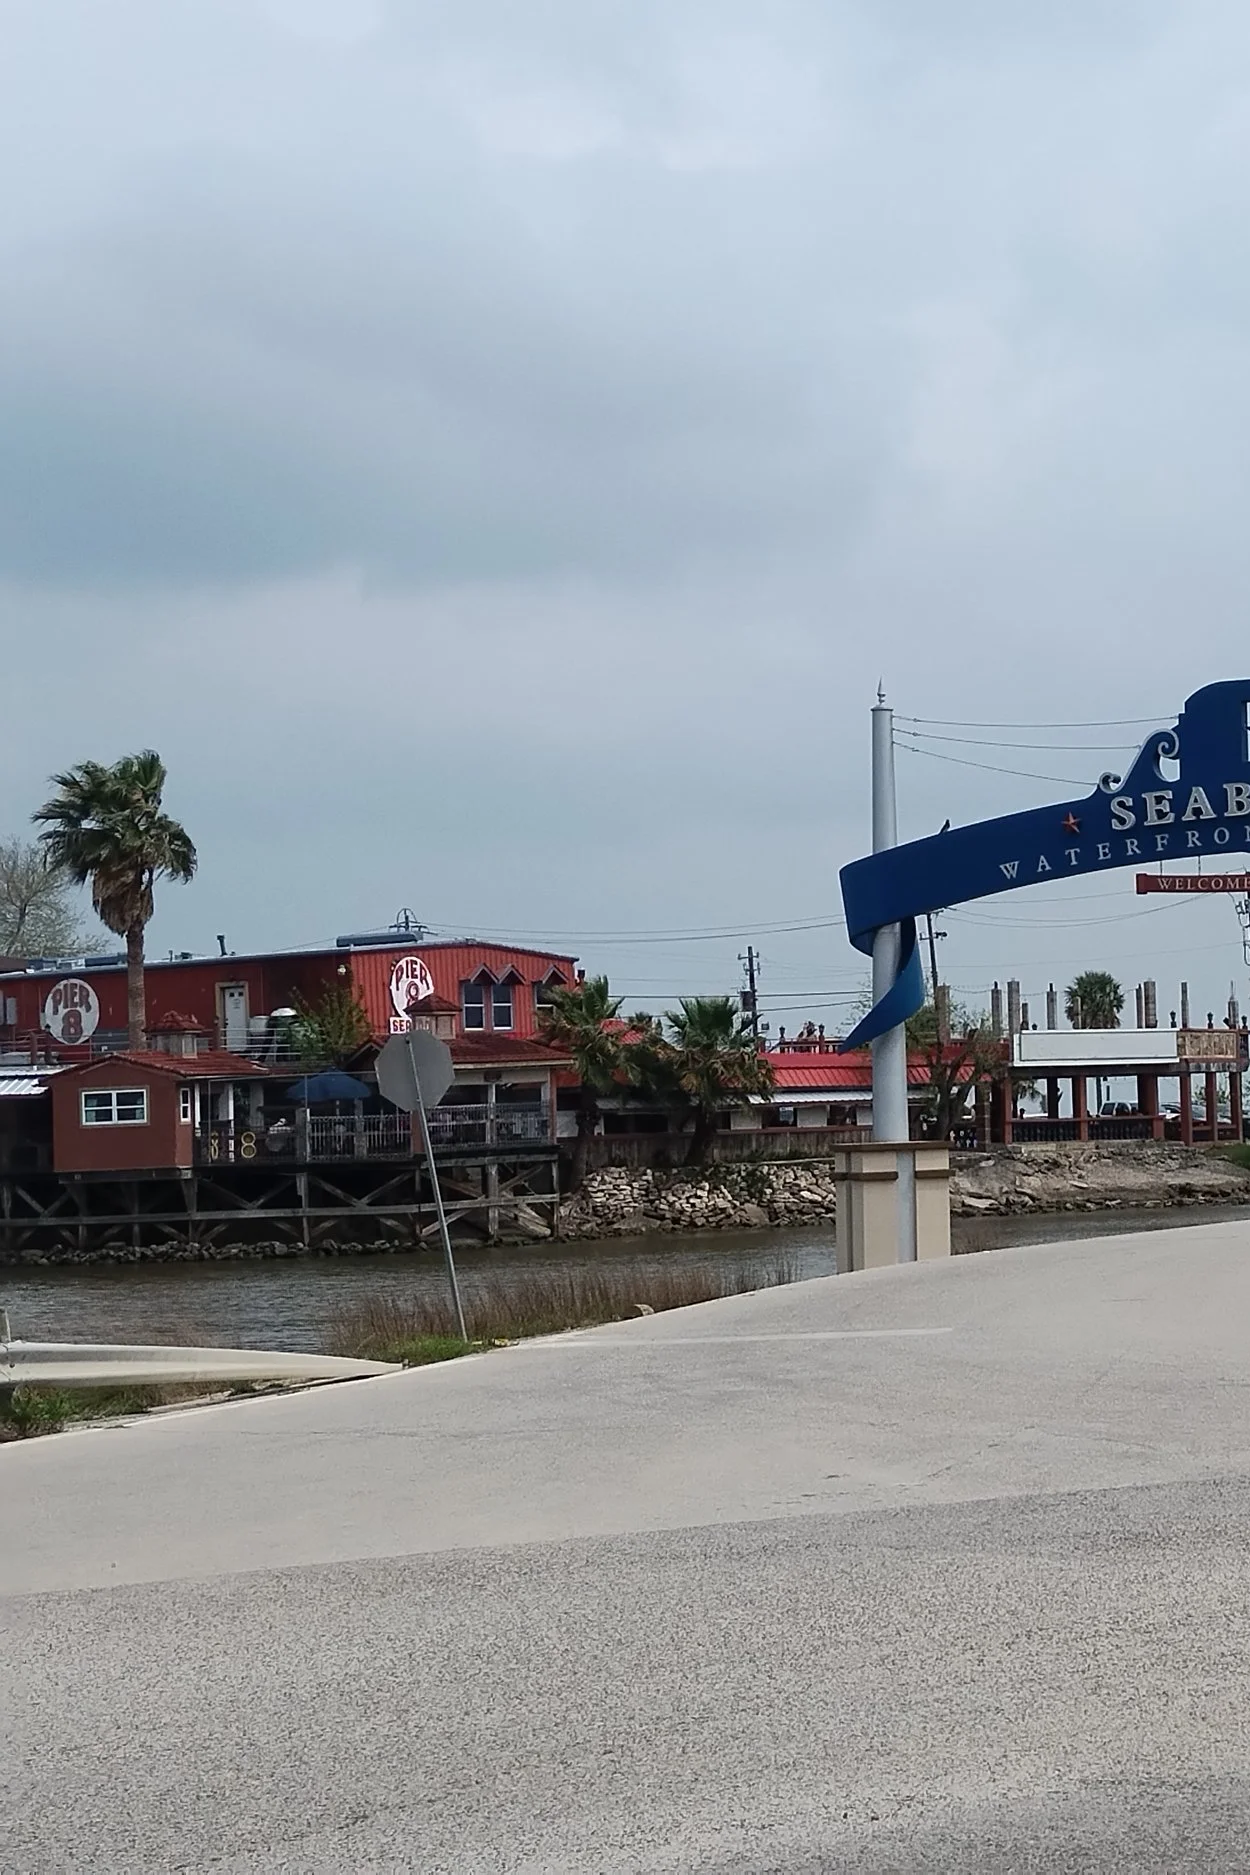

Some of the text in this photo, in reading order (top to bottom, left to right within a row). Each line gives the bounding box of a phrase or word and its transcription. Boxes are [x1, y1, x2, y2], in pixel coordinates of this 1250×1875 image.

[395, 959, 431, 992] PIER
[51, 982, 92, 1016] PIER
[61, 1009, 84, 1044] 8
